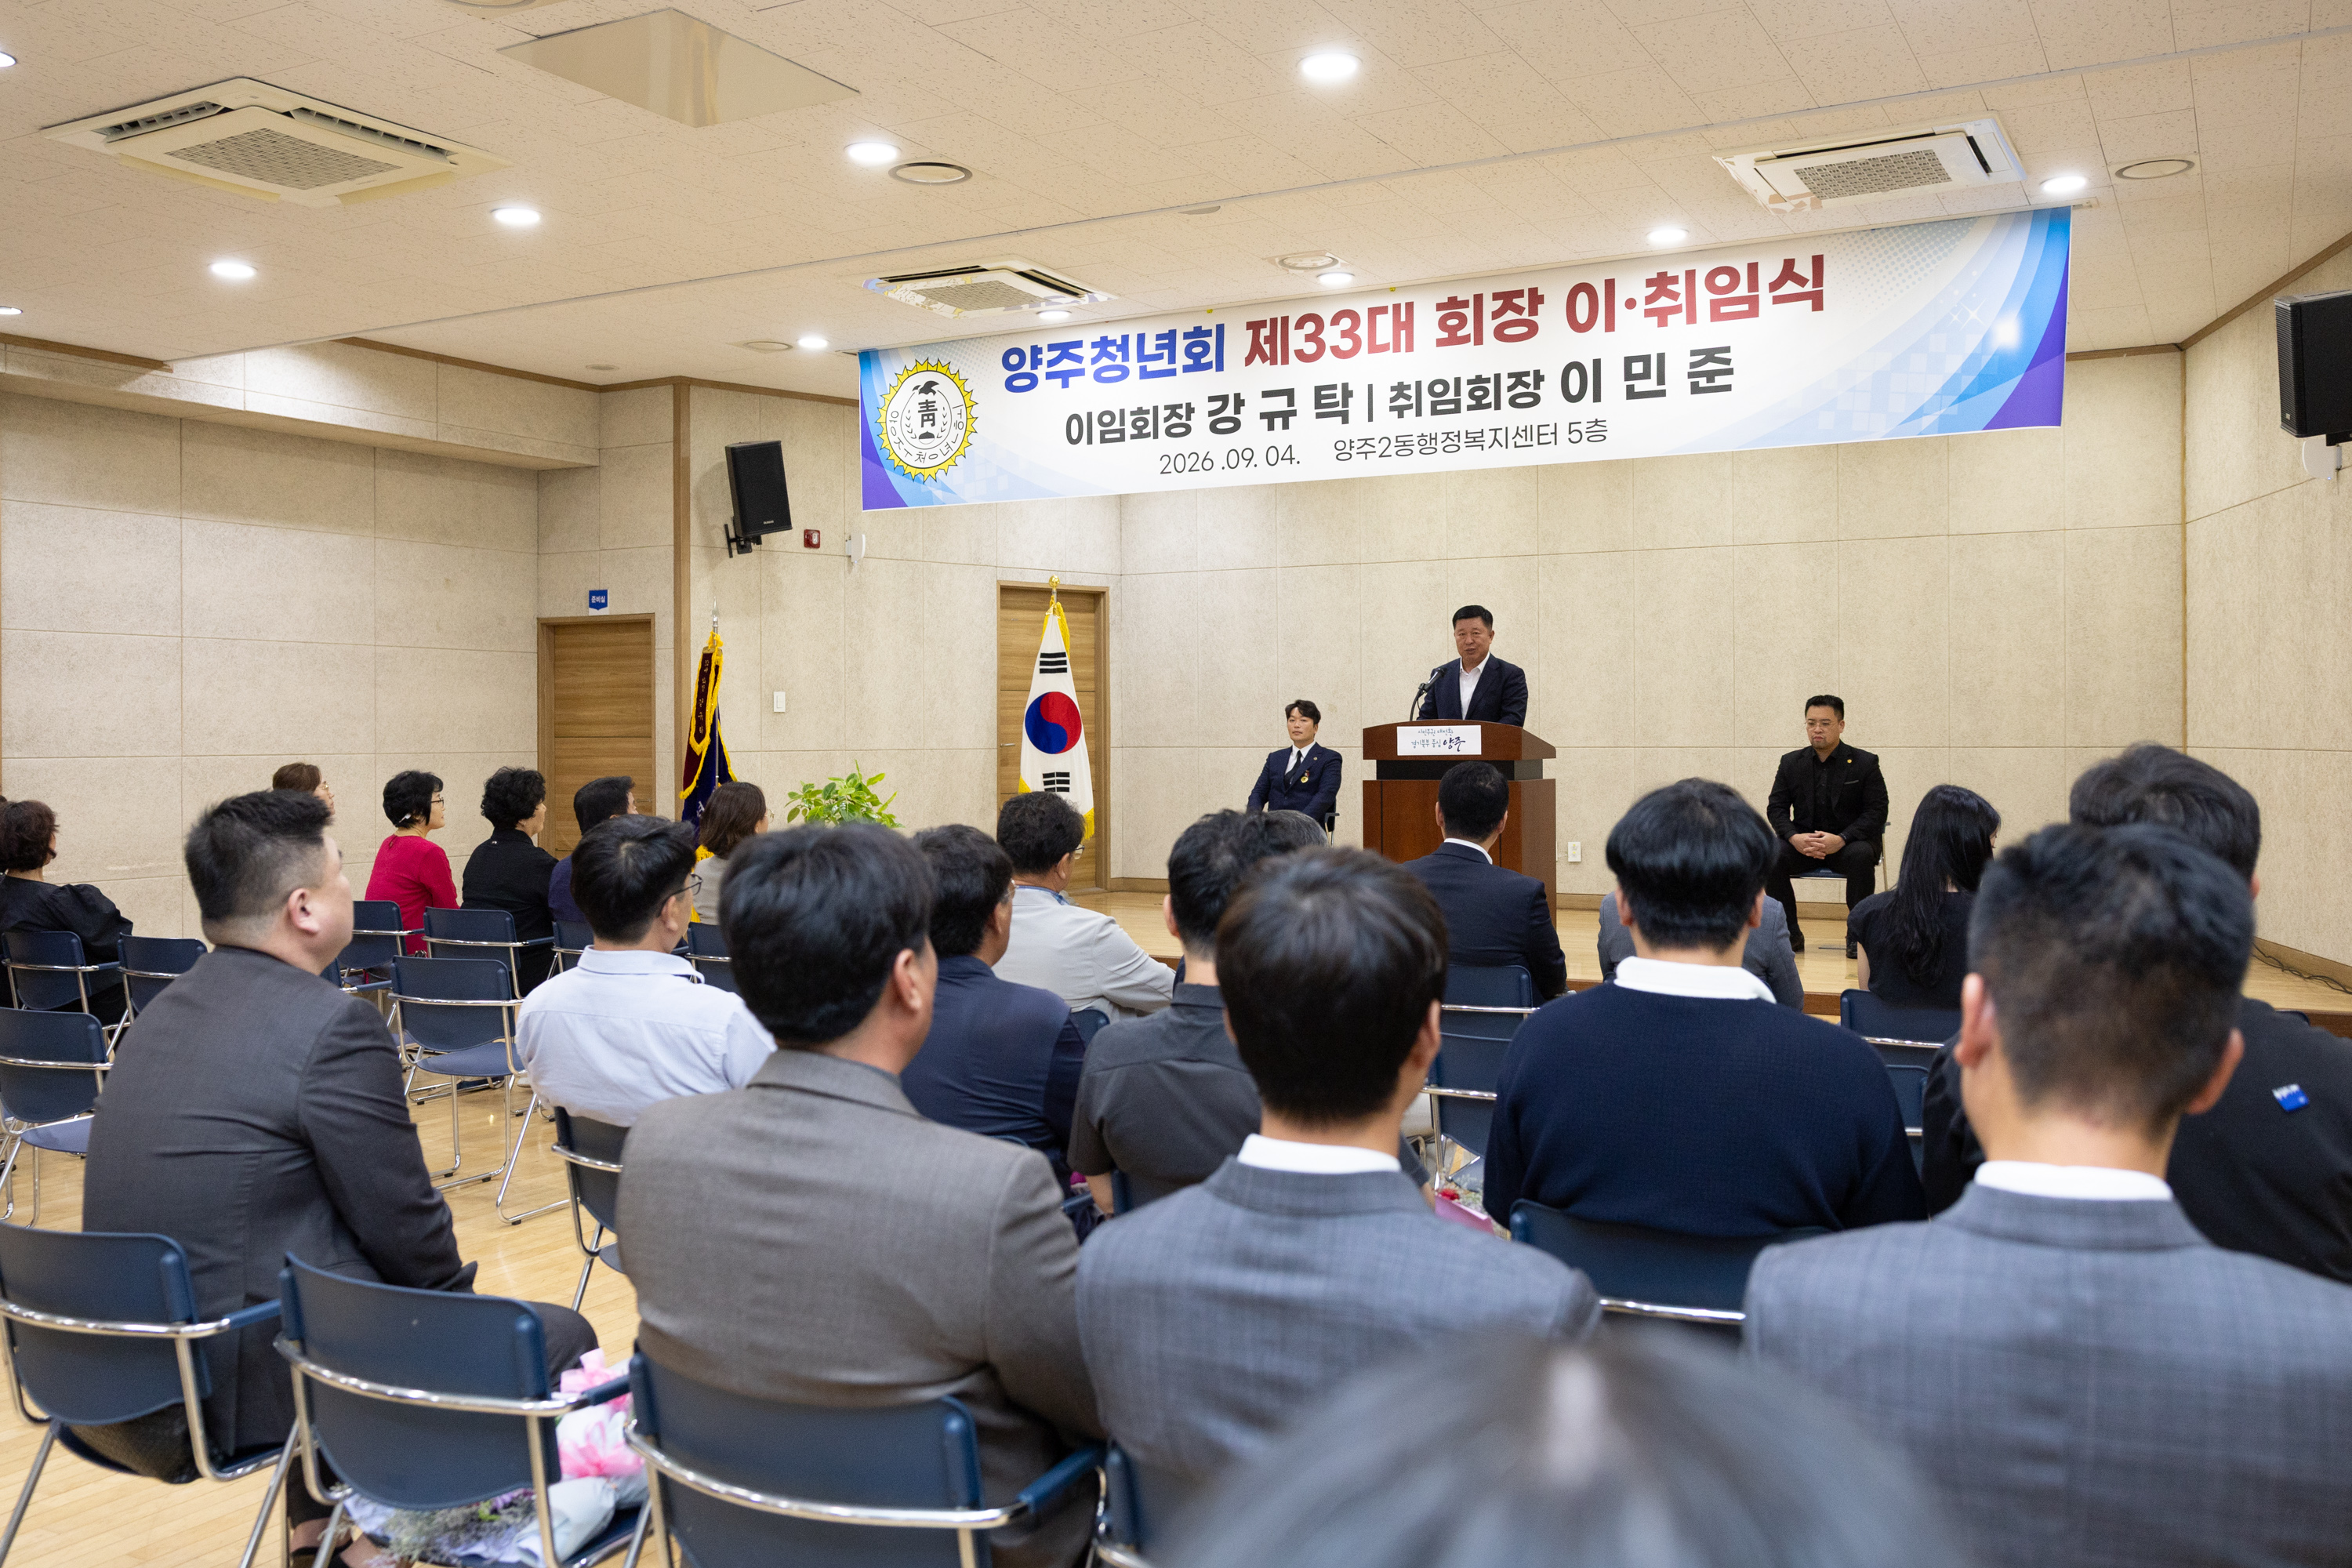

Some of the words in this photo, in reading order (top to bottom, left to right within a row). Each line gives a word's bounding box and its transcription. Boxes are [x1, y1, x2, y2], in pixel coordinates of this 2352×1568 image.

[1001, 324, 1225, 394] 양주청년회
[1244, 302, 1414, 367] 제33대
[1436, 287, 1544, 347] 회장
[1566, 255, 1824, 333] 이·취임식
[1066, 402, 1195, 445] 이임회장
[1208, 392, 1245, 435] 강
[1259, 387, 1298, 432] 규
[1314, 382, 1349, 425] 탁
[1388, 369, 1545, 419] 취임회장
[1560, 358, 1602, 404] 이
[1624, 352, 1667, 401] 민
[1687, 346, 1734, 395] 준
[1160, 451, 1214, 474] 2026
[1265, 444, 1301, 467] 04.
[1334, 423, 1558, 462] 양주2동행정복지센터
[1568, 418, 1608, 445] 5층
[591, 595, 606, 604] 준비실
[1411, 739, 1430, 749] 경기북부
[1432, 739, 1442, 748] 중심
[1443, 736, 1466, 753] 양주
